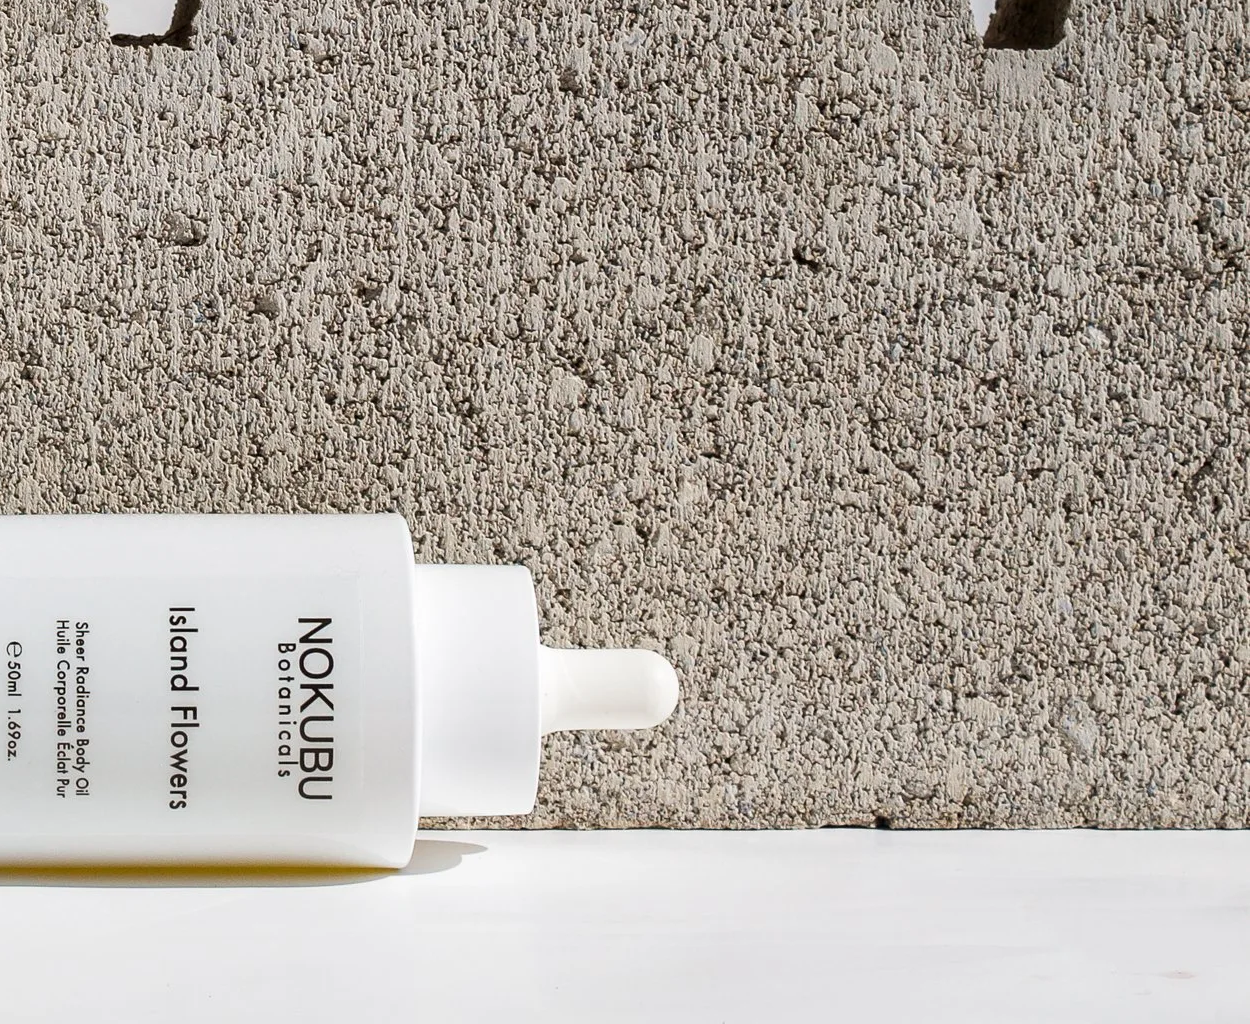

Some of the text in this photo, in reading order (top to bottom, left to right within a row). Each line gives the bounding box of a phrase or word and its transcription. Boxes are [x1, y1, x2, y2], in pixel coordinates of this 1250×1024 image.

[7, 708, 22, 762] 1.69oz.
[52, 619, 75, 799] Huile Corporelle Éclat Pur
[70, 621, 91, 796] Sheer Radiance Body Oil
[168, 607, 201, 810] Island Flowers
[277, 642, 300, 778] Botanicals
[297, 617, 335, 801] NOKUBU
